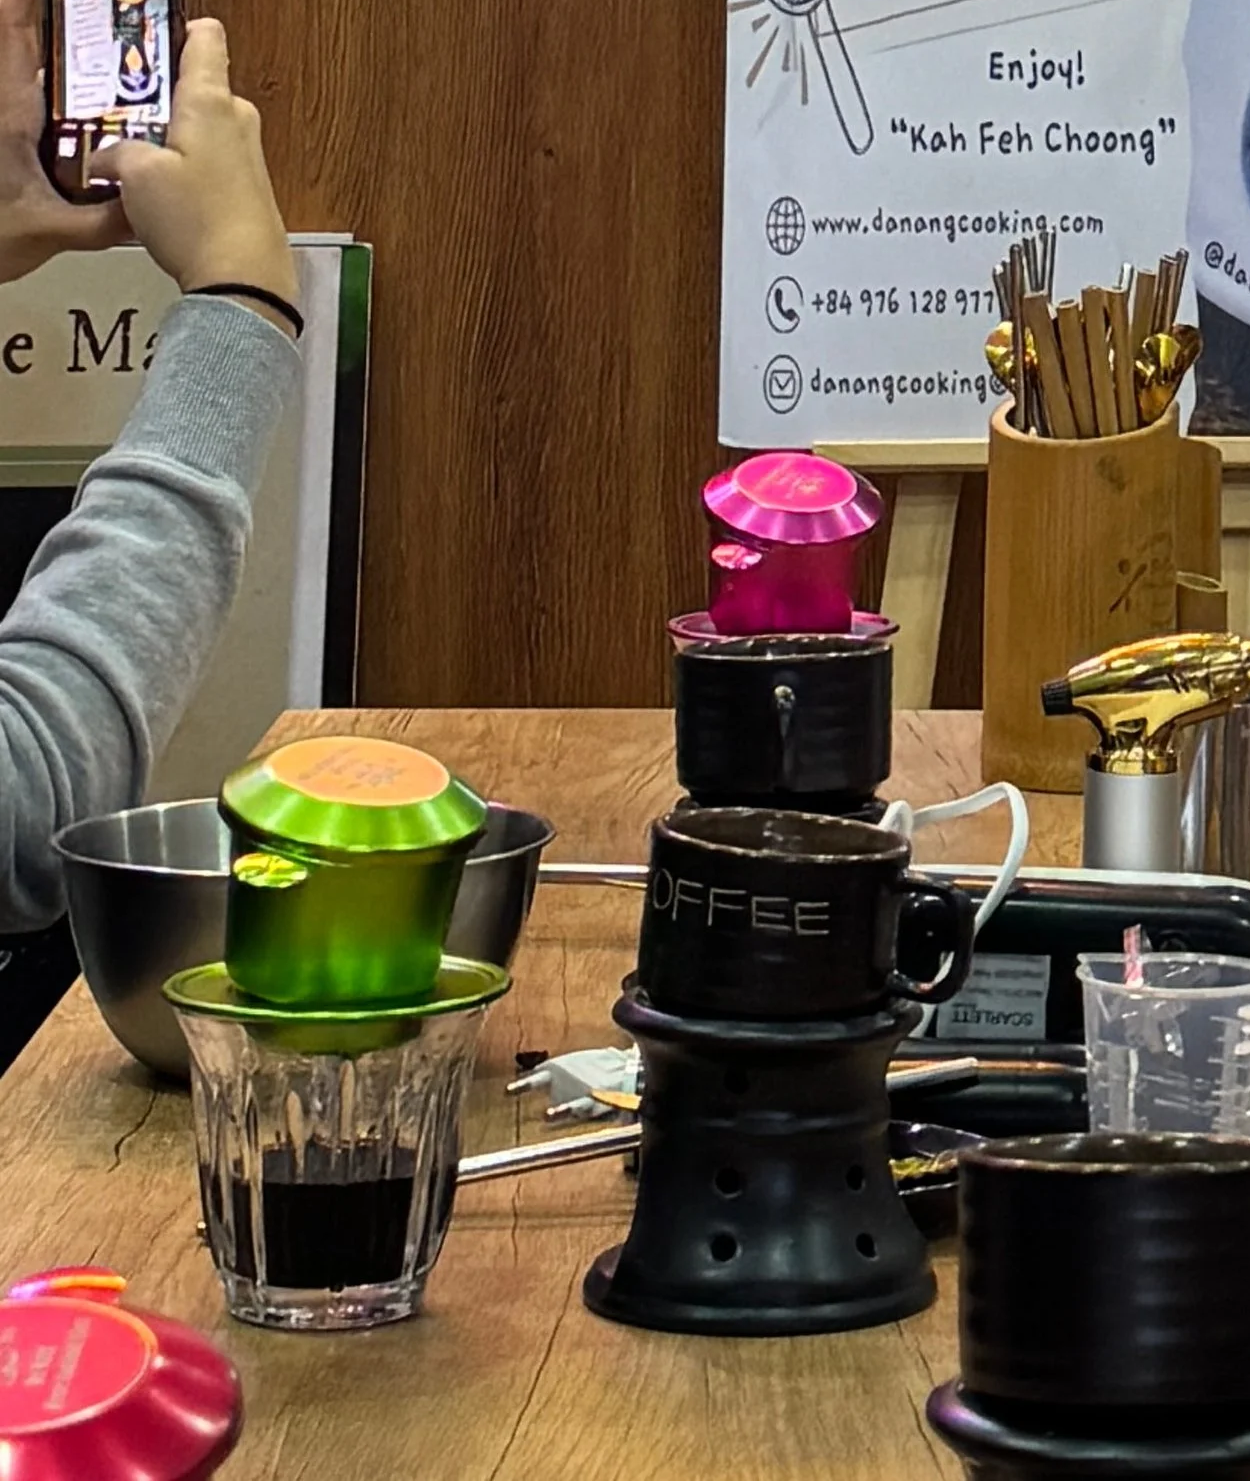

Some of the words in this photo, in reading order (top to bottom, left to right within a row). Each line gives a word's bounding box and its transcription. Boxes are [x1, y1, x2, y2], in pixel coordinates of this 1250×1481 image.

[988, 47, 1086, 90] Enjoy!
[978, 121, 1033, 155] Feh
[811, 206, 1104, 243] www.danangcooking.com
[811, 288, 853, 315] +84
[859, 287, 900, 317] 976
[909, 288, 948, 315] 128
[954, 288, 995, 317] 977
[952, 1009, 1034, 1029] SCARLETT
